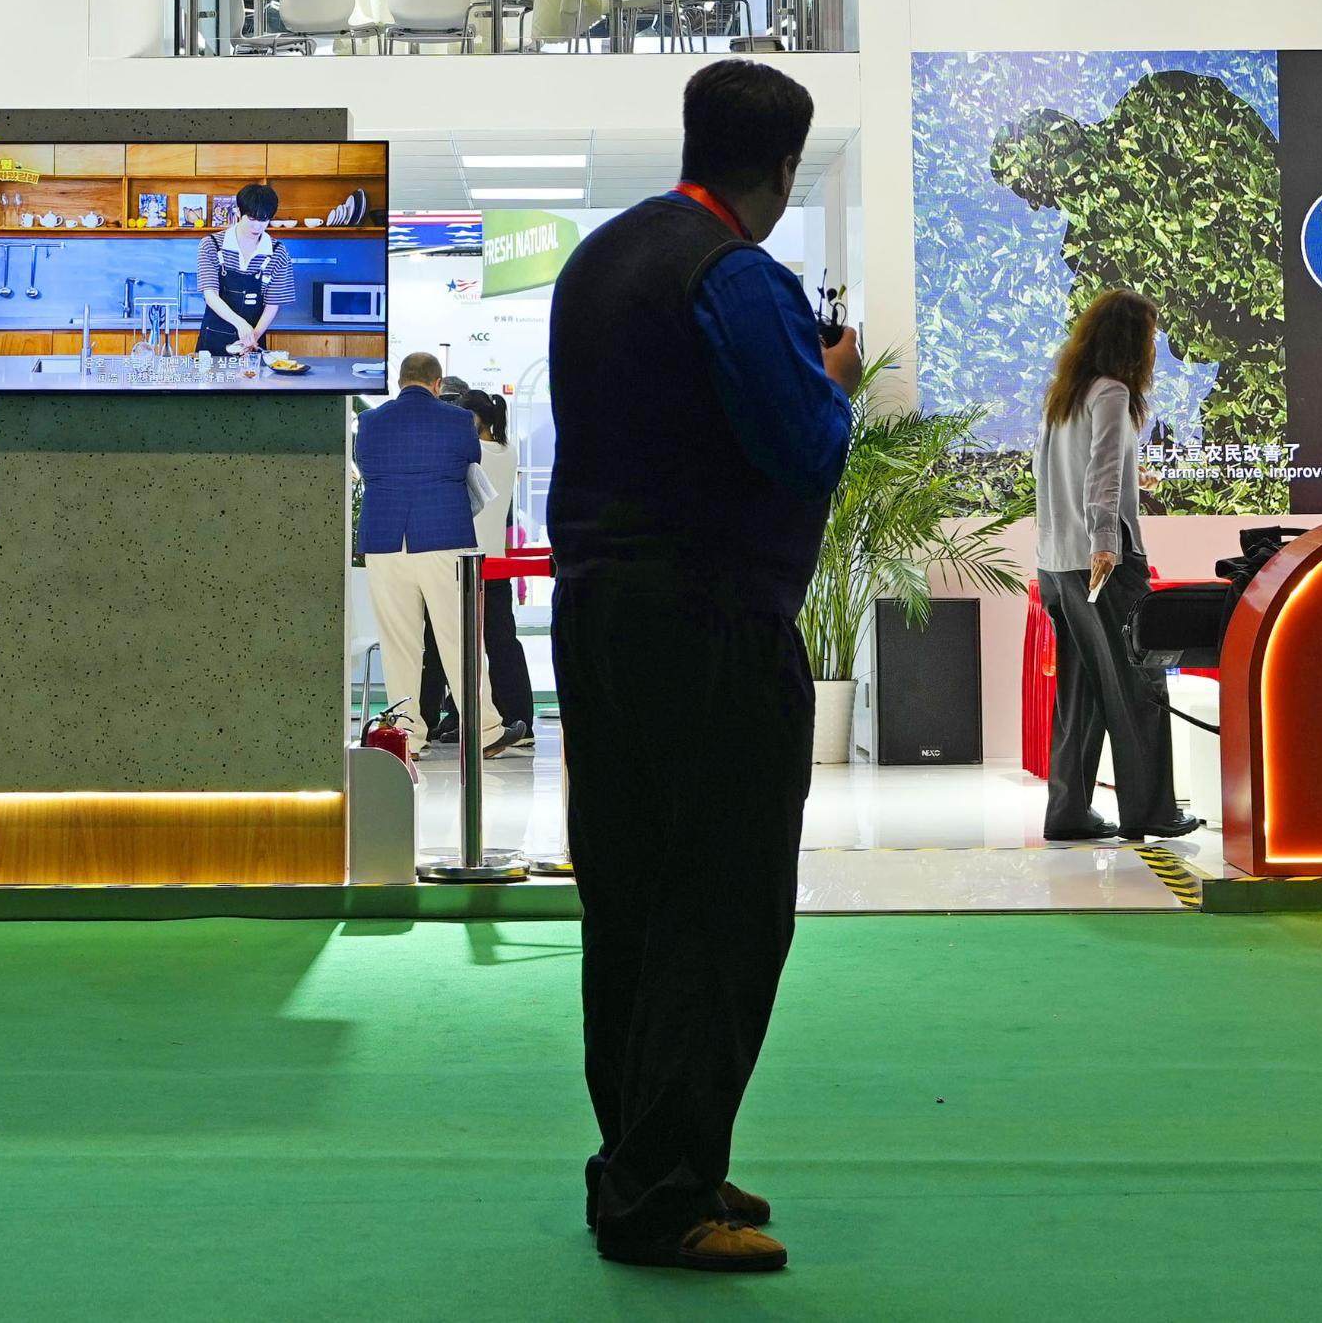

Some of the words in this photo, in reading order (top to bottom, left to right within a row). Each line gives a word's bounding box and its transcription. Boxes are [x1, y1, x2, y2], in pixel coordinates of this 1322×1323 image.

[484, 233, 514, 268] FRESH
[515, 221, 559, 259] NATURAL
[1160, 465, 1220, 479] farmers
[1226, 465, 1262, 479] have
